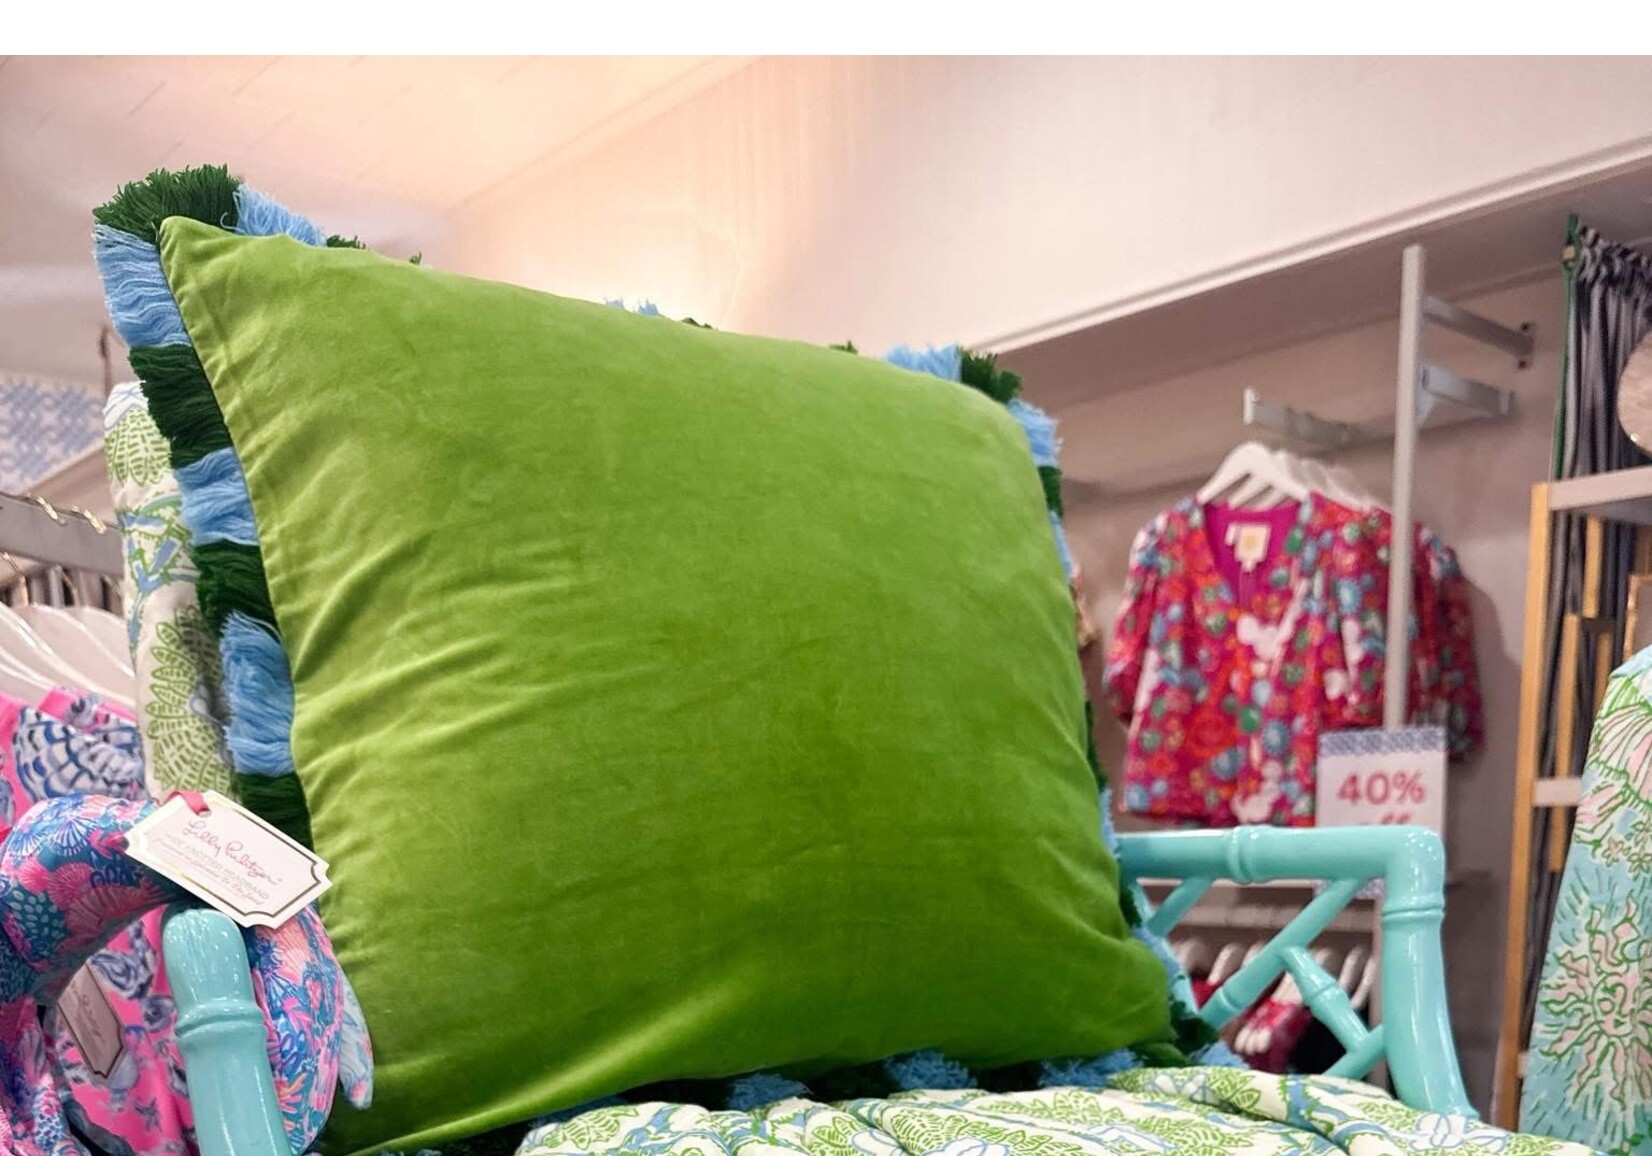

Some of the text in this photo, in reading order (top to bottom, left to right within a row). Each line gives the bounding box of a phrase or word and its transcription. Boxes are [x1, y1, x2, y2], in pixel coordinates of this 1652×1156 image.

[1337, 769, 1428, 806] 40%
[182, 819, 222, 858] Lilly
[224, 840, 278, 886] Pulitzer
